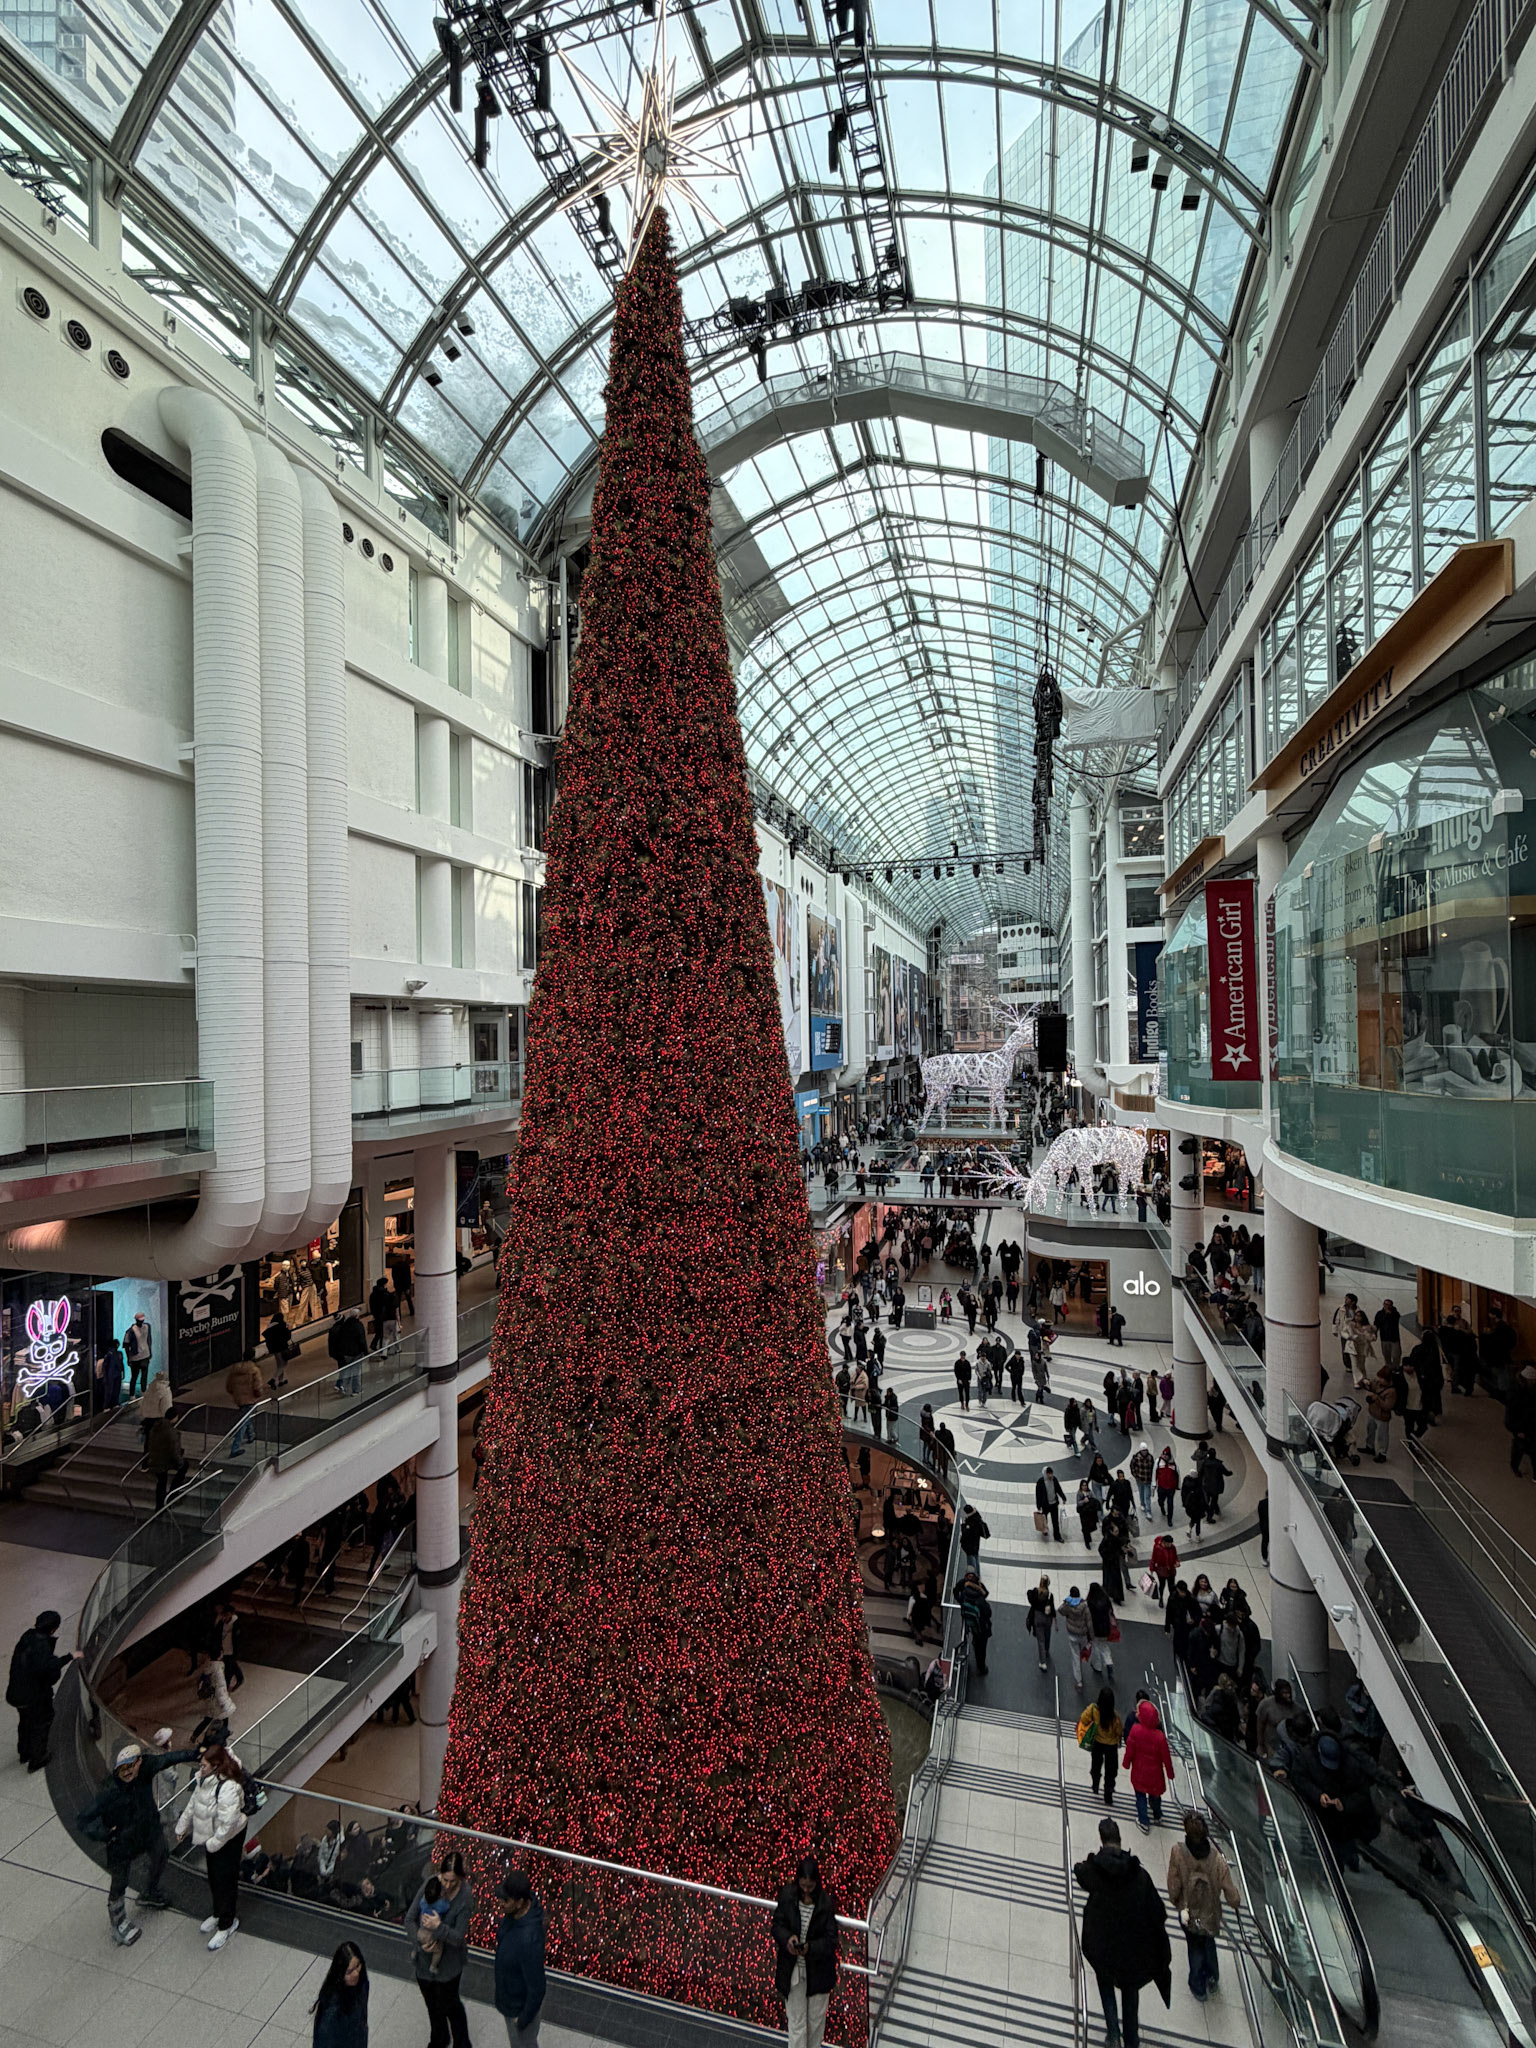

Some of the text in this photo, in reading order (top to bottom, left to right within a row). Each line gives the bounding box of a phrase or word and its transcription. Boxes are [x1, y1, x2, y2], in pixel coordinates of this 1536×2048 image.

[1300, 664, 1395, 777] CREATIVITY
[1443, 858, 1479, 889] Music
[1481, 852, 1496, 877] &
[1494, 834, 1529, 870] Café
[1142, 979, 1160, 1058] Indigo Books
[1219, 939, 1246, 1041] American
[1123, 1270, 1161, 1296] alo
[178, 1321, 210, 1340] Psycho
[211, 1310, 240, 1328] Bunny
